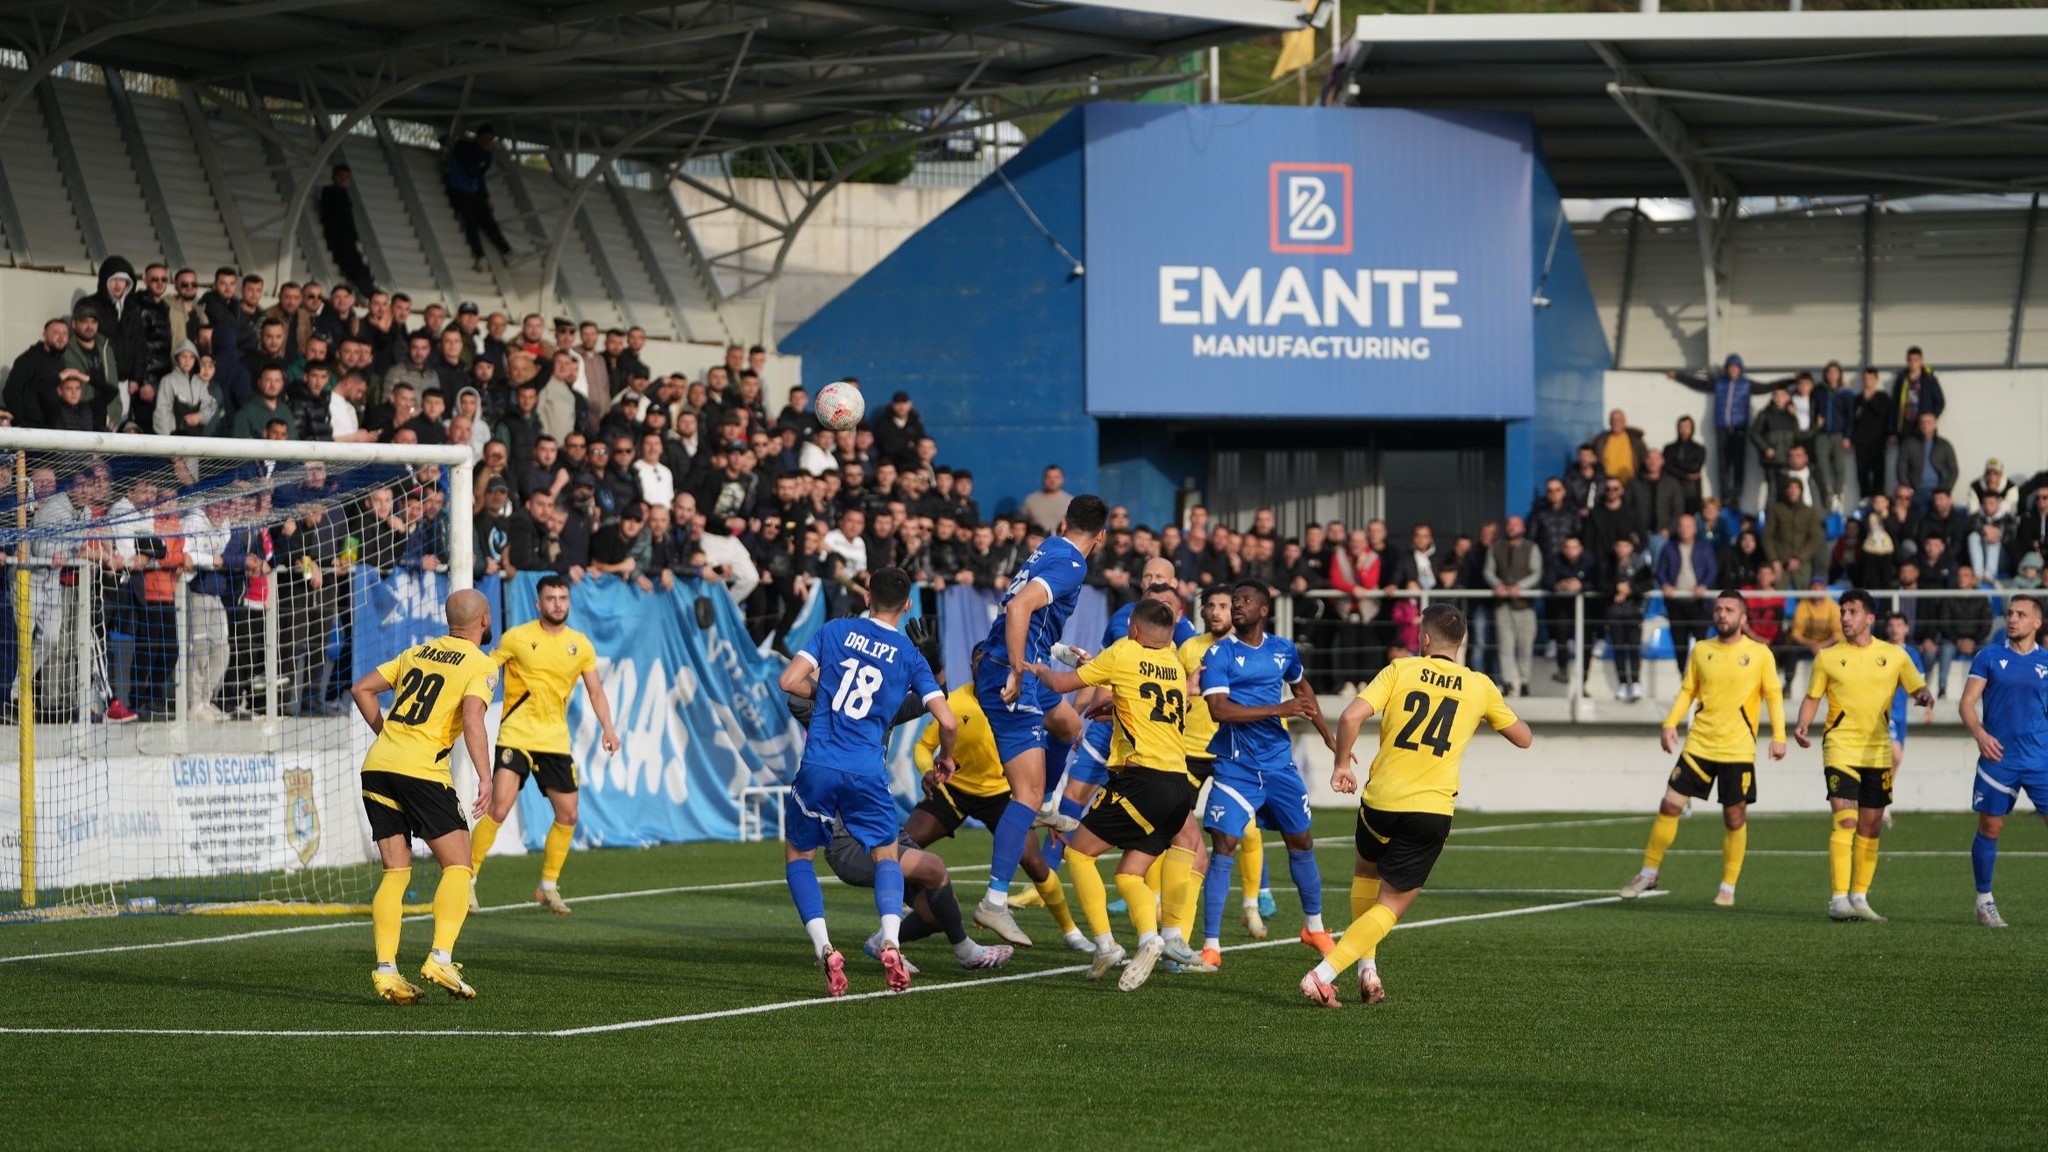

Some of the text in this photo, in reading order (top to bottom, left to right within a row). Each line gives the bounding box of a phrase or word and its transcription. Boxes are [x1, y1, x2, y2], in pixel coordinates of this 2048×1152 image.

[1159, 265, 1463, 329] EMANTE
[1192, 334, 1431, 361] MANUFACTURING
[843, 631, 898, 664] DALIPI
[387, 667, 446, 726] 29
[831, 657, 883, 720] 18
[1420, 668, 1463, 691] STAFA
[1393, 690, 1460, 758] 24
[172, 757, 276, 786] LEKSI SECURITY
